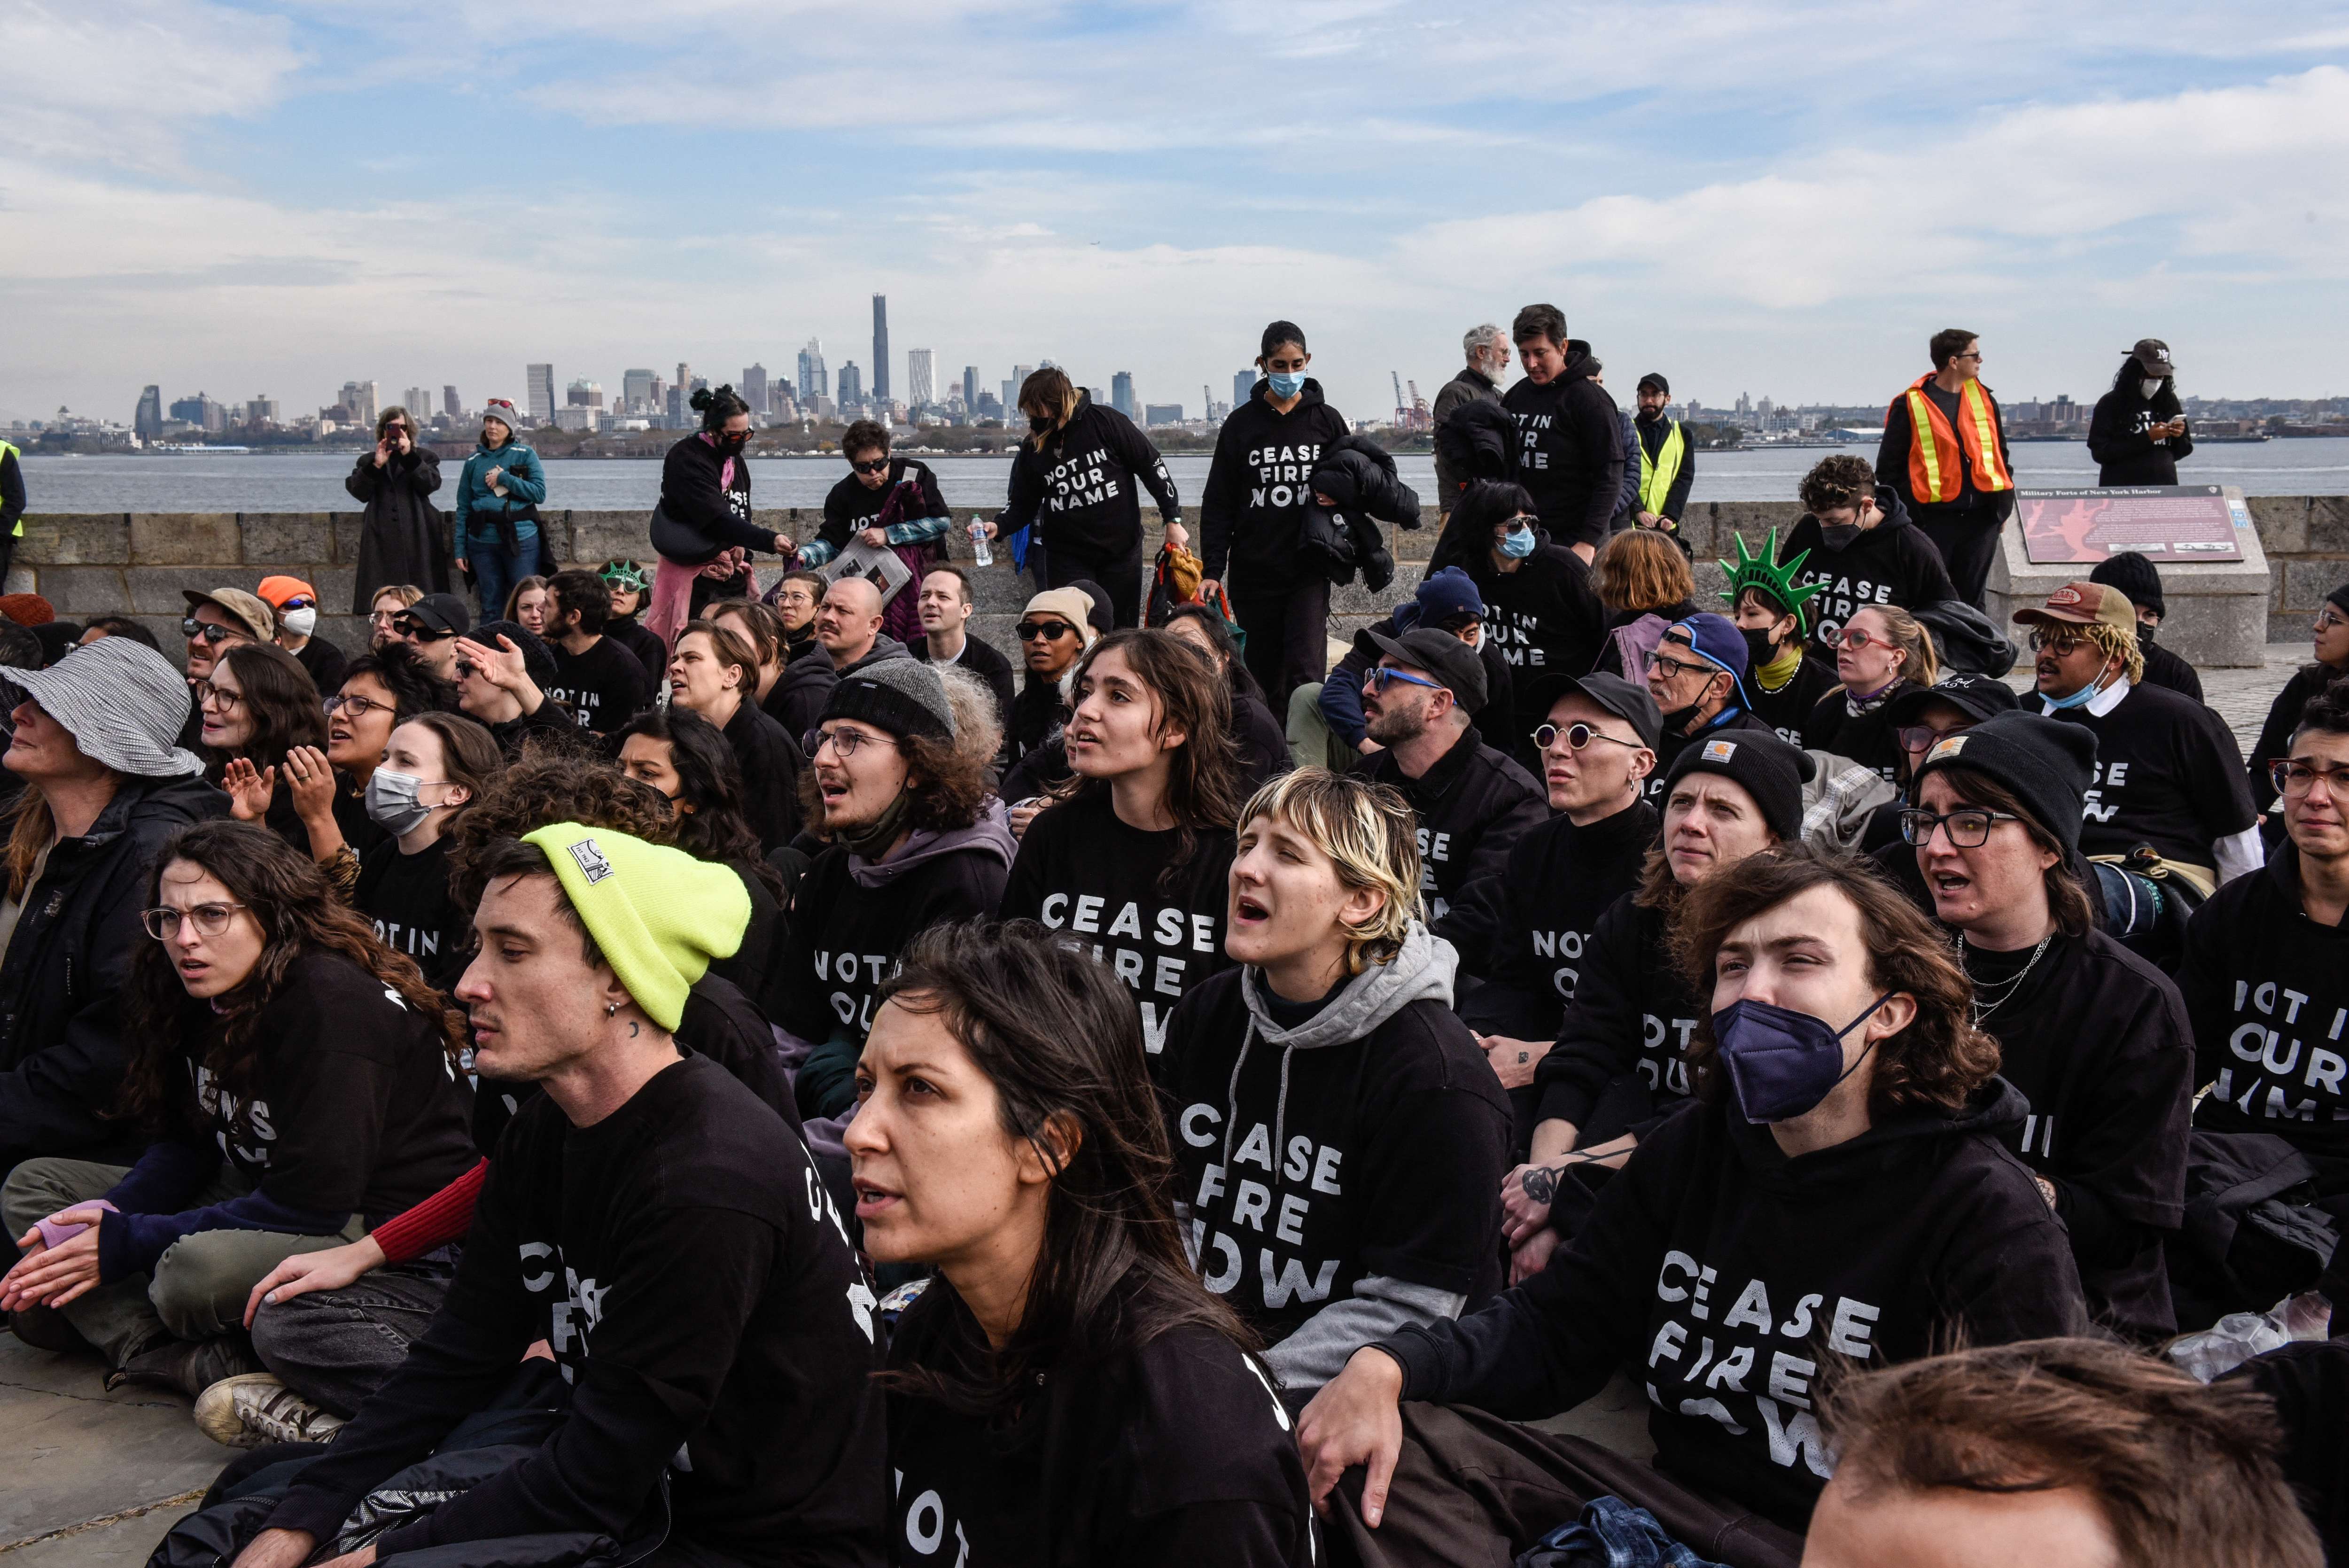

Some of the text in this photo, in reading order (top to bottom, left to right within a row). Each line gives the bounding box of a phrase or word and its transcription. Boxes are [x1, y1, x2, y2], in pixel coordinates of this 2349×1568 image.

[2157, 349, 2169, 362] NY
[1532, 415, 1552, 428] IN
[1044, 449, 1107, 486] NOT IN
[1249, 445, 1320, 466] CEASE
[1519, 451, 1548, 469] ME
[1057, 468, 1105, 495] OUR
[1260, 465, 1313, 483] FIRE
[1050, 480, 1119, 512] NAME
[1802, 571, 1891, 604] CEASE
[1482, 604, 1537, 630] OT IN
[1494, 644, 1546, 666] ME
[581, 691, 599, 707] IN
[374, 919, 440, 956] OT IN
[1042, 893, 1215, 952] CEASE
[1532, 930, 1591, 959] NO
[1643, 1013, 1699, 1050] OT
[2230, 1023, 2347, 1095] OUR
[1636, 1057, 1708, 1095] OU
[1180, 1103, 1343, 1195] CASE
[1196, 1163, 1310, 1246] FRE
[1657, 1250, 1880, 1358] CEASE
[1648, 1320, 1816, 1409] FIRE
